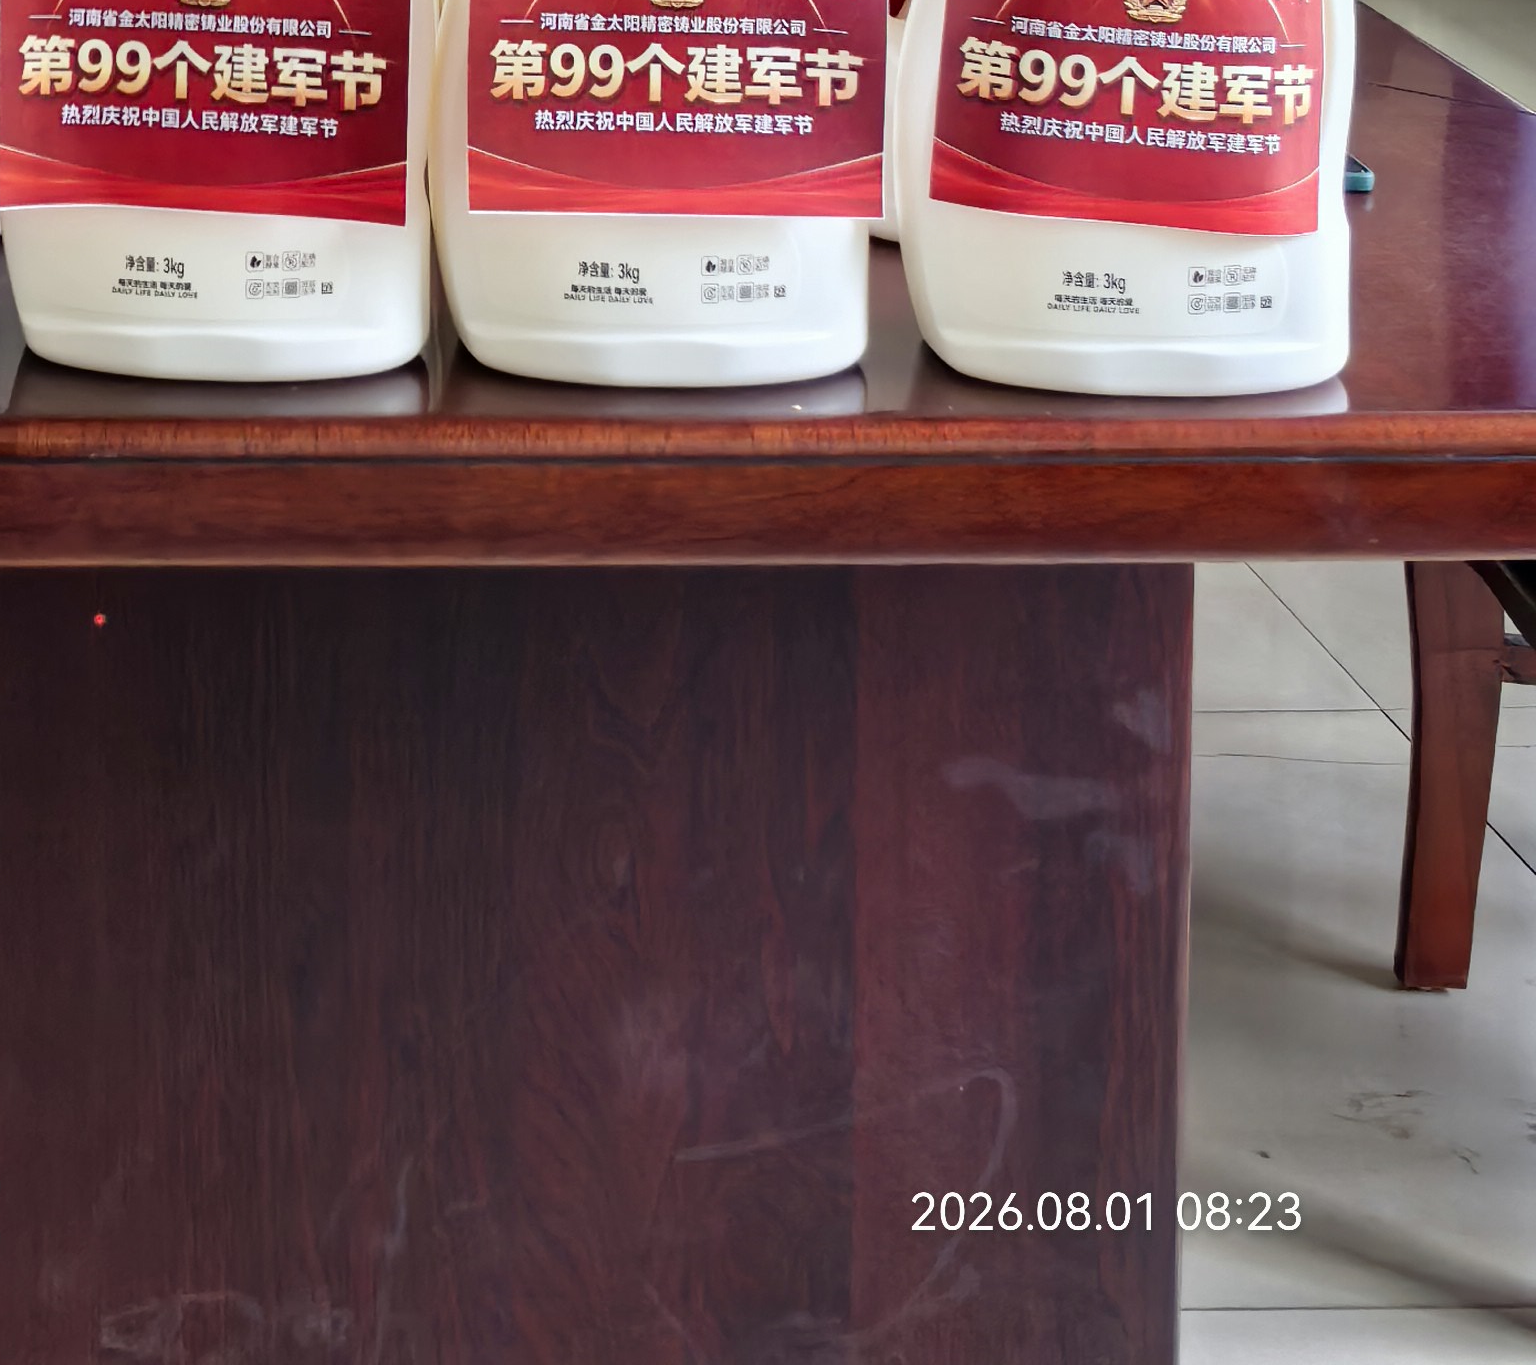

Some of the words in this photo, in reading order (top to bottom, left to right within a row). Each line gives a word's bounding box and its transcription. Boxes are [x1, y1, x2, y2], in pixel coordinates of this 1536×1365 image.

[68, 7, 333, 39] 河南省金太阳精密铸业股份有限公司
[539, 12, 807, 36] 河南省金太阳精密铸业股份有限公司
[1010, 15, 1277, 54] 河南省金太阳精密铸业股份有限公司
[18, 35, 388, 111] 第99个建军节
[490, 39, 864, 106] 第99个建军节
[957, 37, 1318, 125] 第99个建军节
[61, 103, 339, 138] 热烈庆祝中国人民解放军建军节
[535, 109, 814, 135] 热烈庆祝中国人民解放军建军节
[1000, 111, 1282, 155] 热烈庆祝中国人民解放军建军节
[125, 255, 159, 273] 净含量:
[163, 257, 185, 279] 3kg
[578, 260, 614, 279] 净含量:
[617, 262, 640, 284] 3kg
[1062, 270, 1099, 289] 净含量:
[1102, 272, 1126, 294] 3kg
